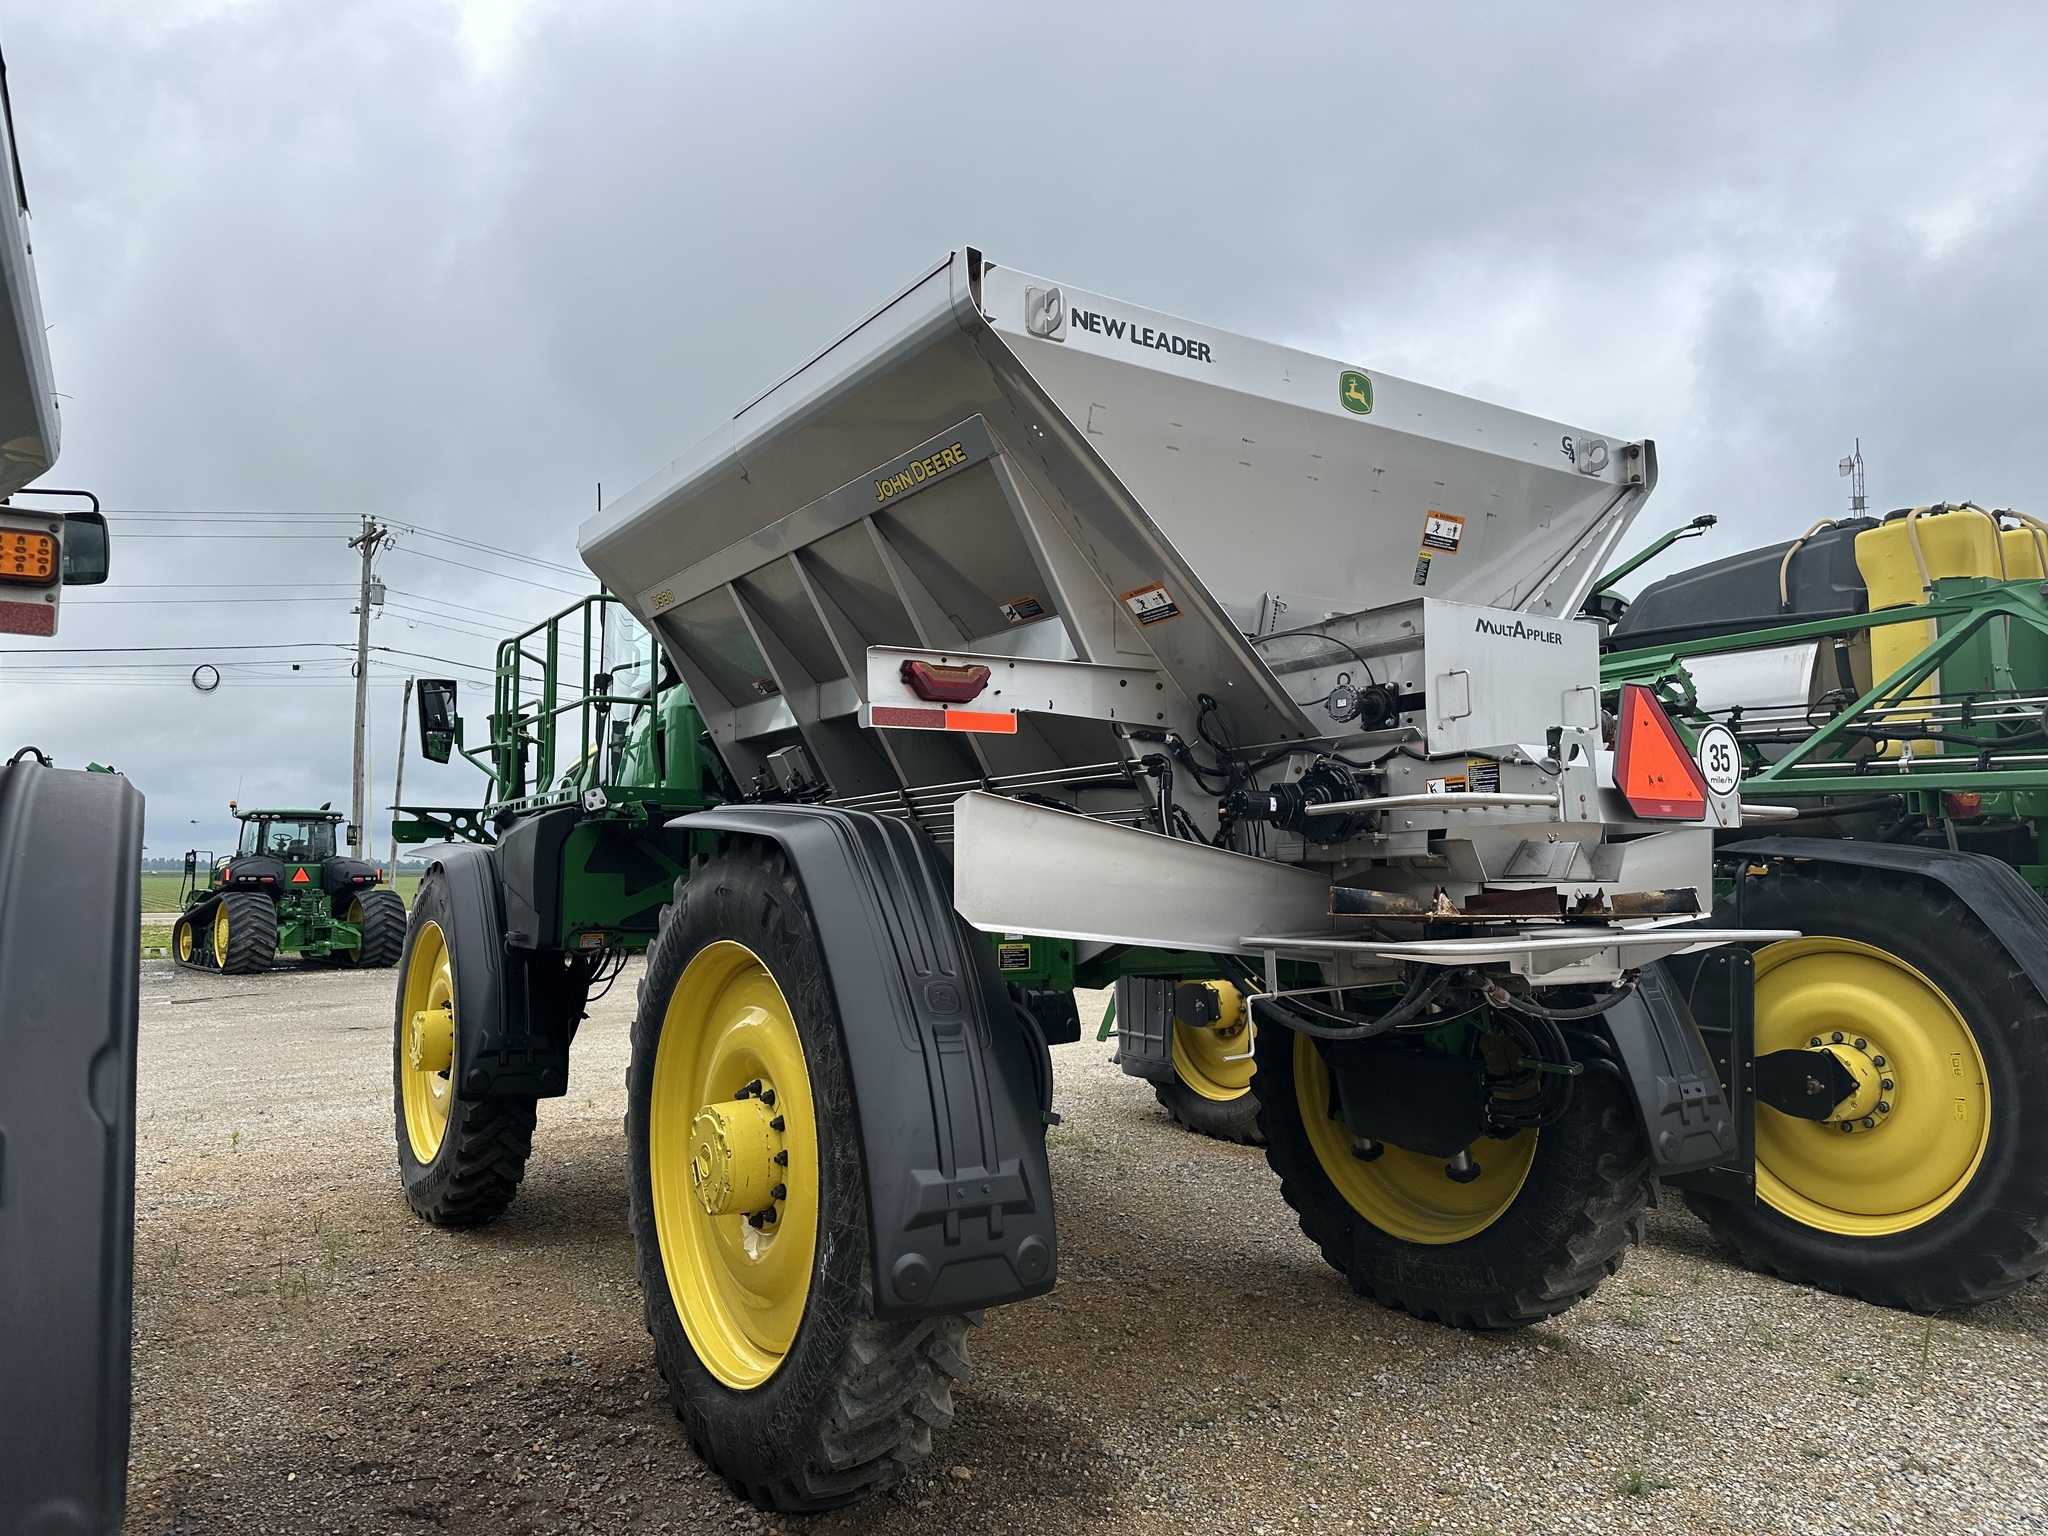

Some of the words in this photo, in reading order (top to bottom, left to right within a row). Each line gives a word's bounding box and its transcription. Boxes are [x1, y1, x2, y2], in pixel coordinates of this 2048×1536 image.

[1071, 307, 1127, 340] NEW
[1130, 323, 1212, 364] LEADER
[873, 468, 915, 503] JOHN
[908, 441, 968, 484] DEERE
[650, 588, 676, 611] DS30
[1709, 743, 1731, 773] 35
[1710, 775, 1733, 784] mile/h
